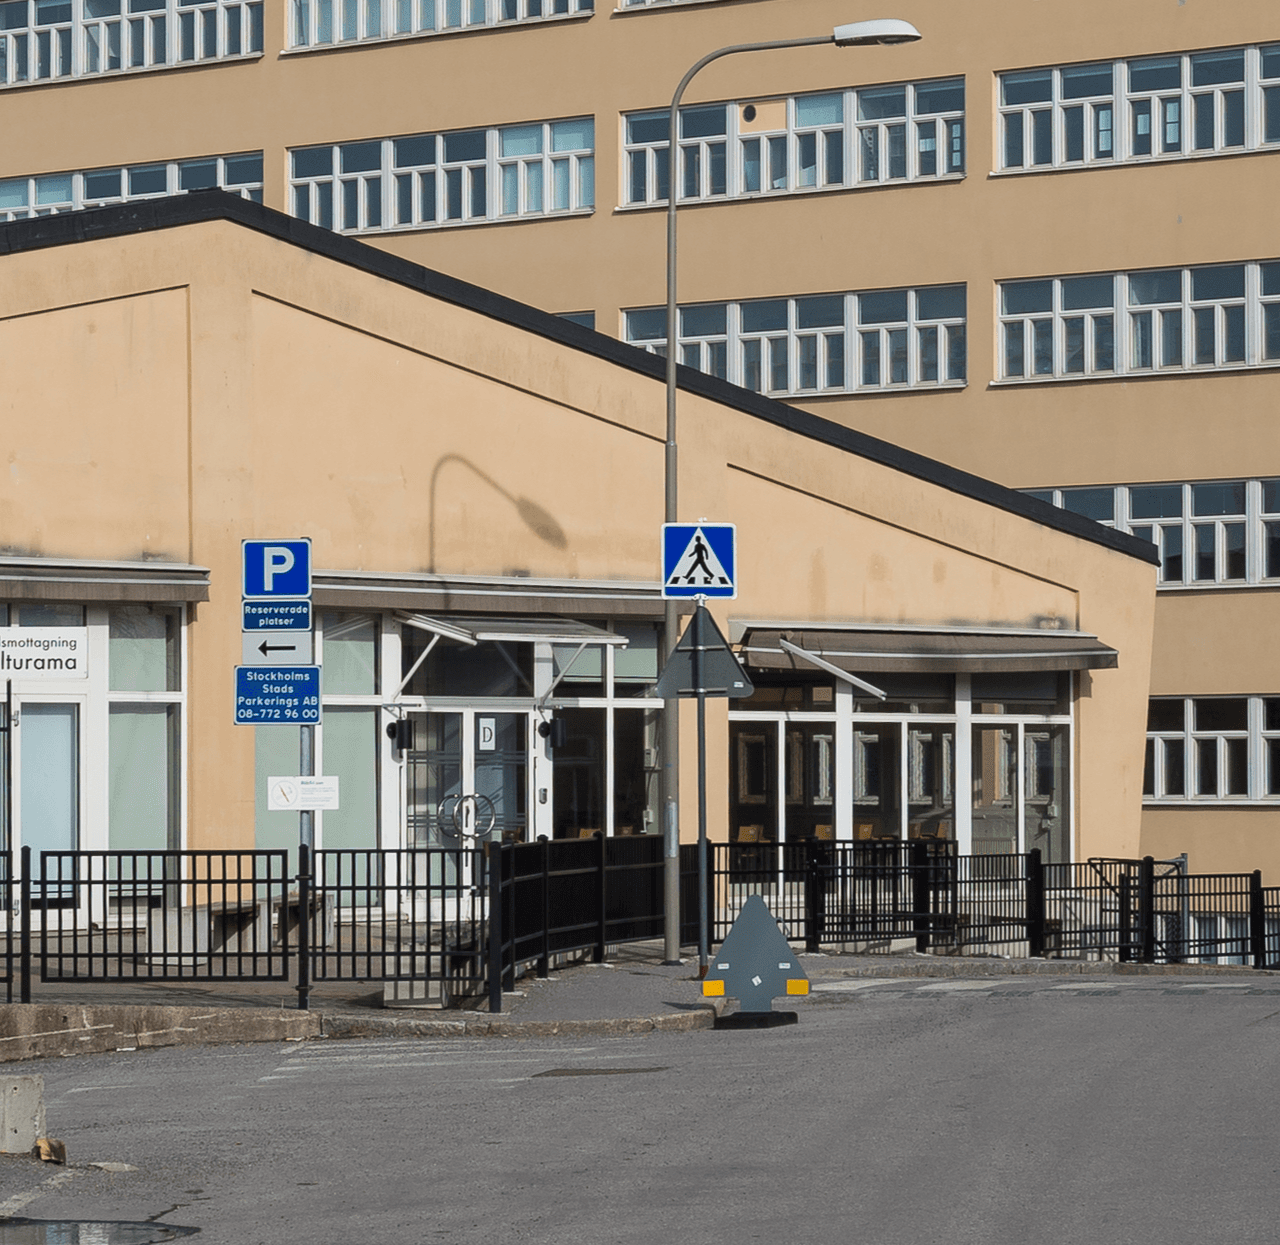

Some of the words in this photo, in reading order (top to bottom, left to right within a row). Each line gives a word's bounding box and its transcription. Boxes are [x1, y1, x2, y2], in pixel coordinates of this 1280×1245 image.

[263, 546, 295, 592] P
[244, 605, 308, 615] Reserverade
[258, 617, 295, 628] platser
[246, 671, 311, 681] Stockholms
[262, 683, 294, 694] Stads
[237, 696, 299, 706] Parkerings
[302, 696, 319, 706] AB
[237, 708, 281, 719] 08-772
[284, 708, 299, 719] 96
[302, 708, 318, 719] 00
[482, 726, 493, 743] D
